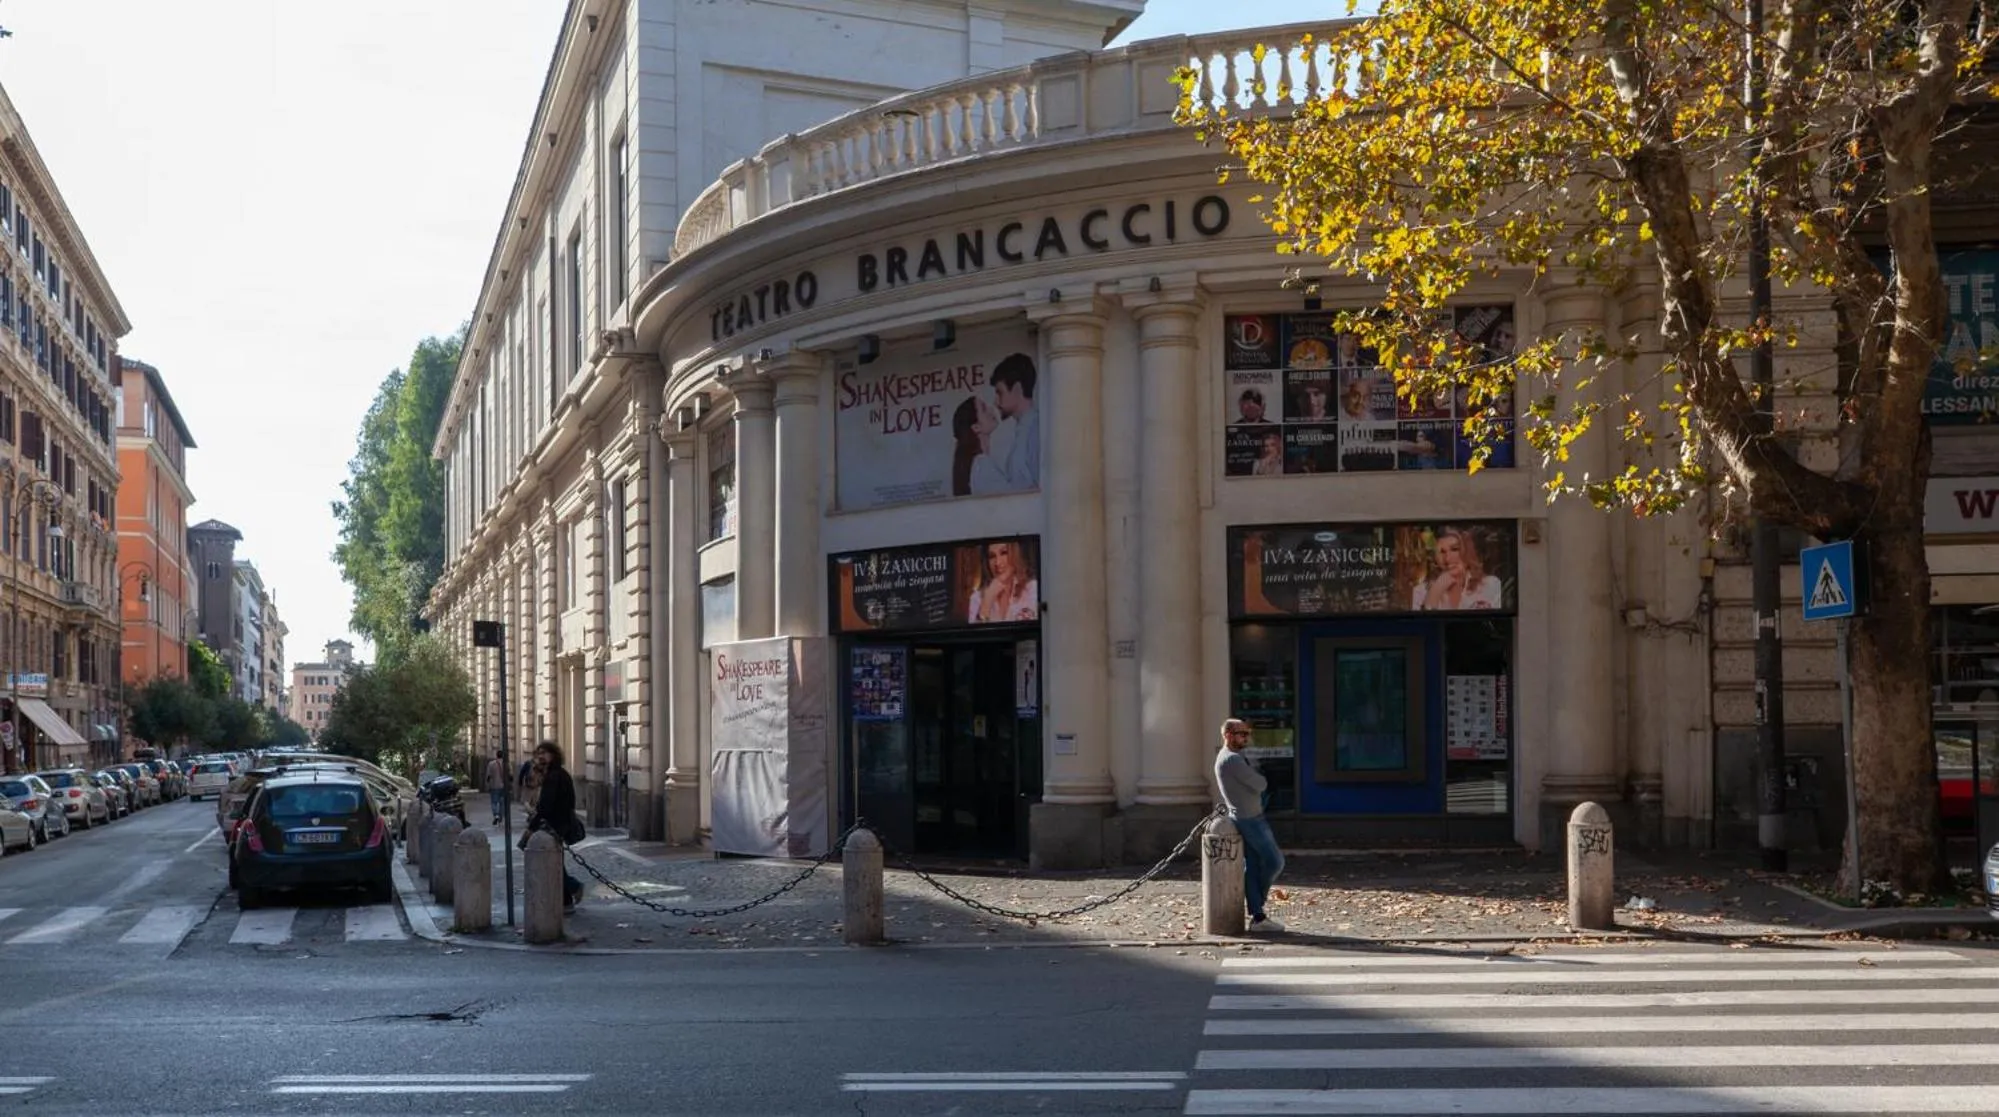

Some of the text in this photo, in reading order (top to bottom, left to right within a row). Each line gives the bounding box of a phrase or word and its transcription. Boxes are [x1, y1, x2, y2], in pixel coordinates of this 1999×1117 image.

[710, 194, 1231, 342] TEATRO BRANCACCIO
[839, 363, 985, 411] SHAKESPEARE
[1920, 396, 1999, 414] LESSAN
[869, 404, 943, 435] IN LOVE
[853, 555, 948, 577] IVA ZANICCHI
[1263, 547, 1390, 565] IVA ZANICCHI
[717, 654, 783, 682] SHAKESPEARE
[736, 680, 763, 703] LOVE
